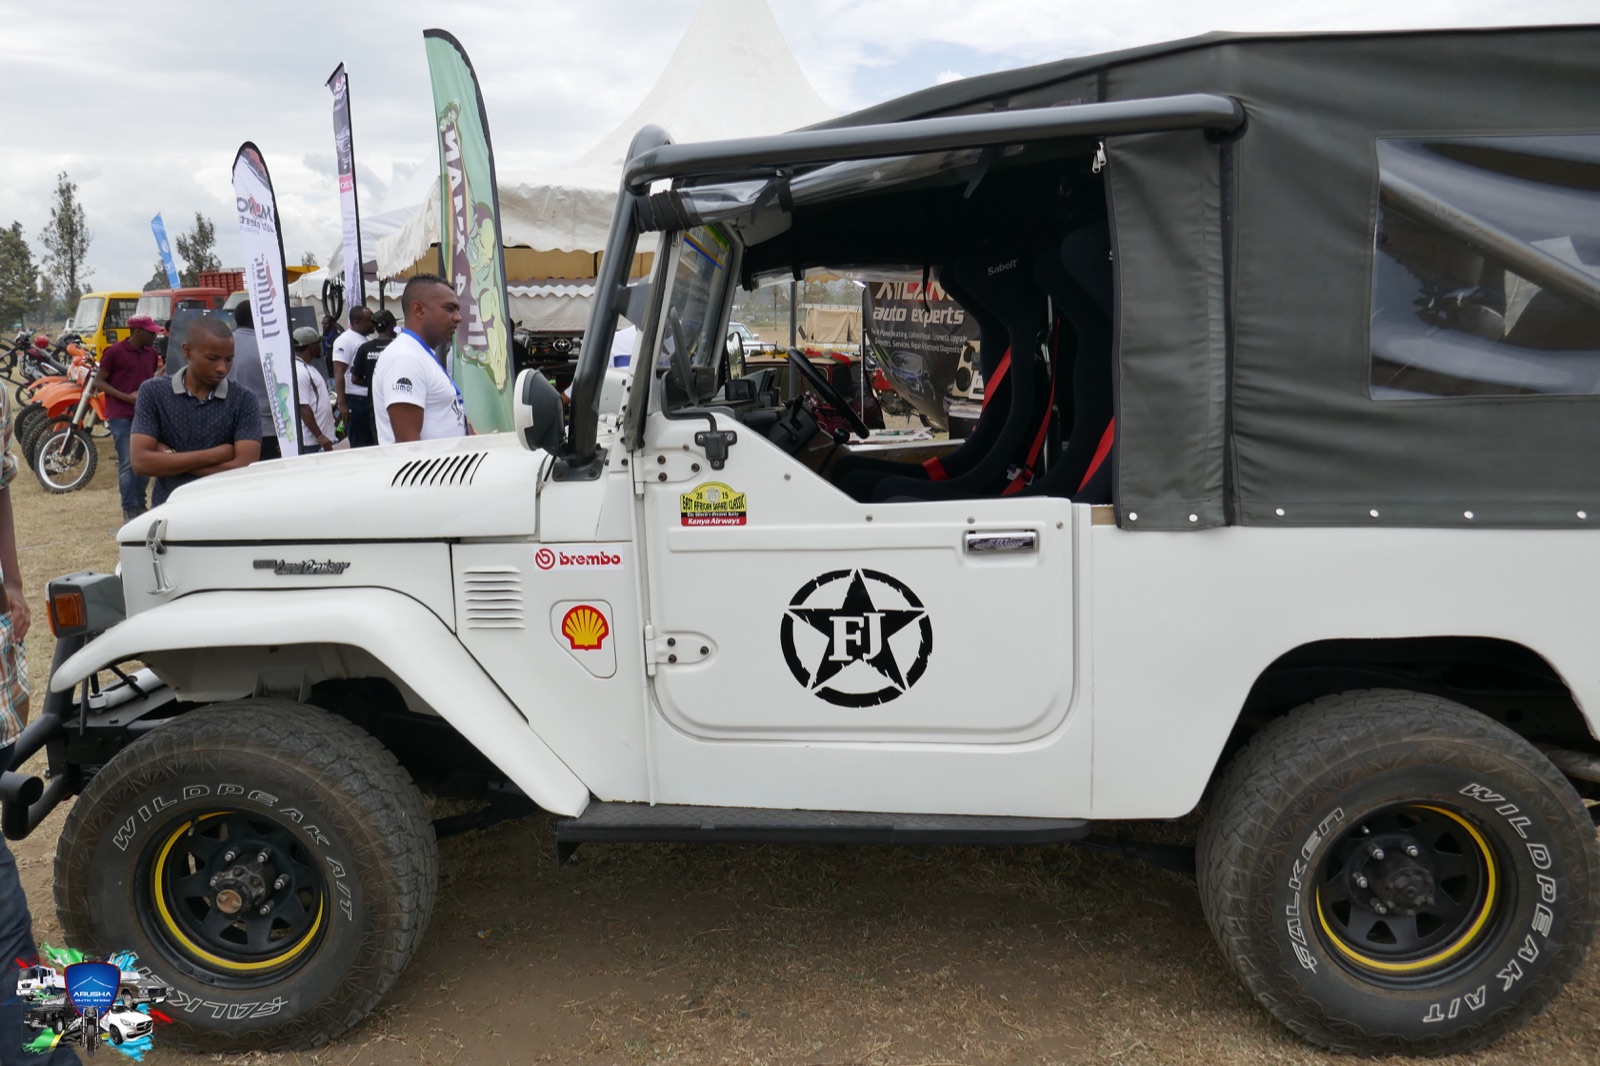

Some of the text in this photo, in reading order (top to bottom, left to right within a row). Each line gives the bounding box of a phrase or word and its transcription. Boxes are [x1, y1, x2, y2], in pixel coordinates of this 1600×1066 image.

[872, 306, 965, 328] auto experts
[682, 494, 745, 511] EAST AFRICAN SAFARI CLASSIC
[696, 492, 703, 500] 20
[688, 517, 740, 526] Kenya Airways
[559, 551, 621, 566] brembo
[828, 612, 886, 661] FJ
[113, 784, 330, 851] WILDPEAK
[1459, 783, 1557, 992] WILDPEAK
